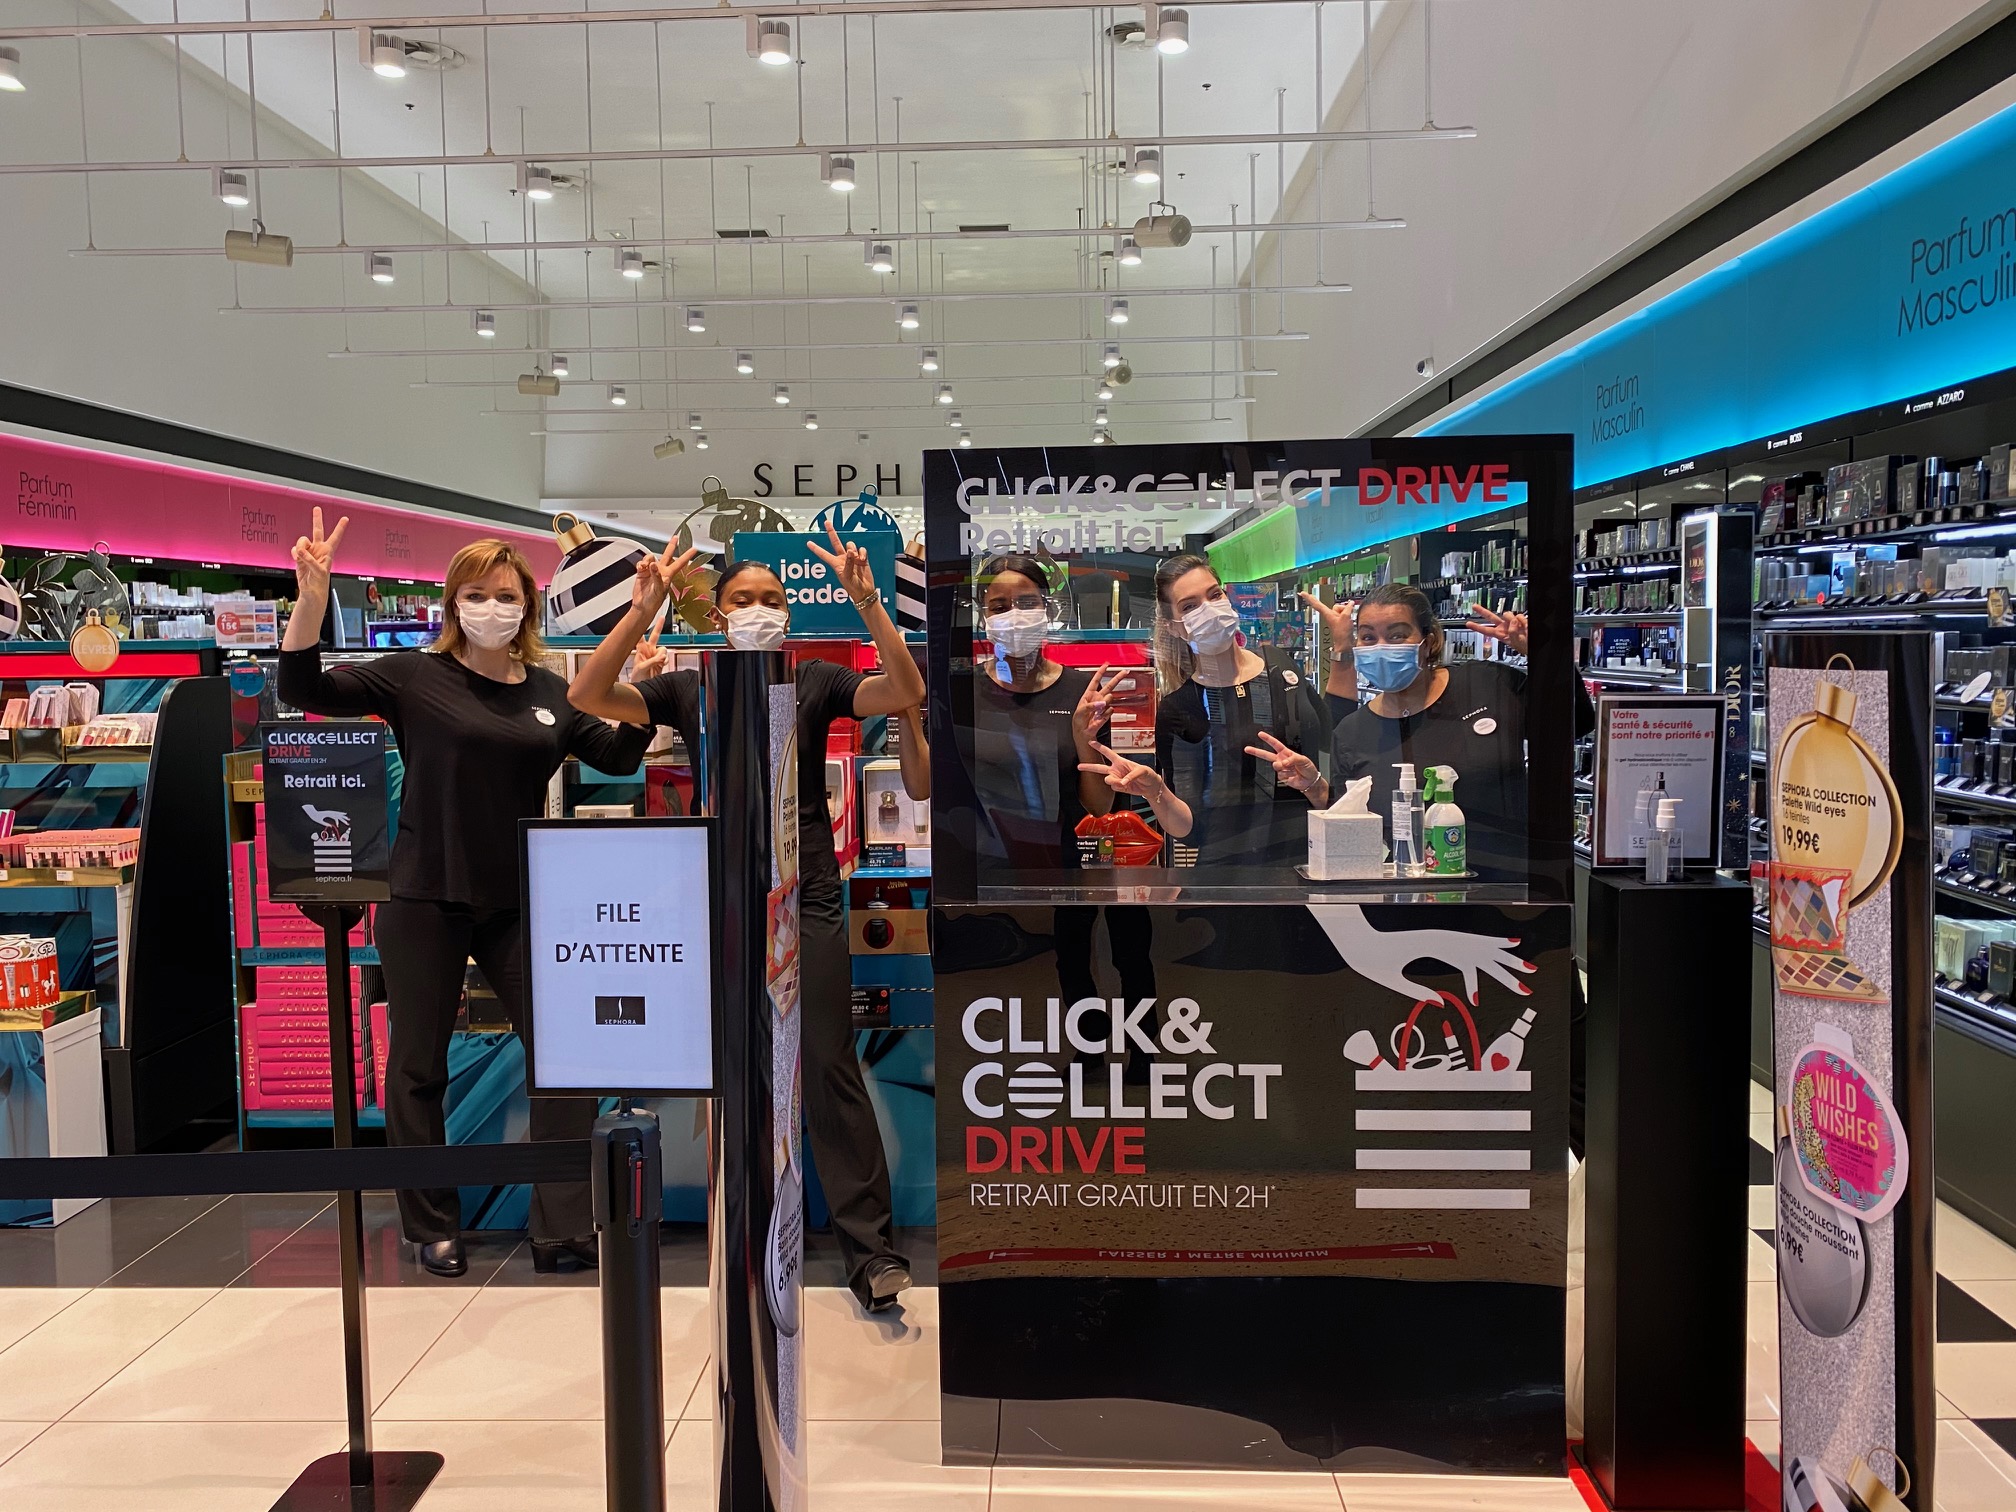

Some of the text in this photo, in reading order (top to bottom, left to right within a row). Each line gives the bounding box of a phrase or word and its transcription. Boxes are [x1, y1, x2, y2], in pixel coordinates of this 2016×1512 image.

[1911, 207, 2016, 284] Parfum
[1597, 375, 1639, 413] Parfum
[1904, 390, 1964, 414] A comme AZZARO
[1592, 401, 1644, 445] Masculin
[1790, 432, 1802, 444] BOSS
[19, 472, 73, 498] Parfum
[753, 463, 902, 497] SEPH
[1358, 464, 1510, 506] DRIVE
[18, 495, 77, 521] Féminin
[242, 506, 276, 527] Parfum
[241, 525, 279, 544] Féminin
[386, 529, 408, 546] Parfum
[959, 518, 1178, 555] Retrait ici.
[386, 544, 410, 559] Féminin
[780, 558, 827, 583] joie
[785, 584, 889, 604] cade.
[221, 622, 237, 630] 15€
[1725, 663, 1742, 722] DIOR
[1612, 711, 1639, 719] Votre
[1612, 720, 1693, 729] santé & sécurité
[1611, 730, 1714, 741] sont notre priorité #1
[268, 746, 312, 758] DRIVE
[284, 774, 366, 788] Retrait ici.
[1782, 781, 1876, 807] SEPHORA COLLECTION
[1782, 795, 1846, 818] Palette Wild eyes
[1790, 809, 1810, 824] teintes
[1632, 837, 1682, 845] SERA
[1782, 824, 1820, 854] 19,99€
[315, 875, 352, 883] sephora.fr
[596, 903, 641, 923] FILE
[283, 936, 323, 945] SEPHO
[253, 951, 375, 960] SEPHORA COTION
[555, 942, 684, 963] D'ATTENTE
[280, 971, 327, 979] SEPHOR
[280, 987, 328, 996] SEPHOR
[279, 1003, 328, 1012] SEPHOR
[280, 1019, 328, 1027] SEPHOR
[961, 996, 1218, 1055] CLICK&
[281, 1035, 329, 1043] SEPHOR
[283, 1067, 332, 1075] SEPHOR
[961, 1061, 1283, 1121] COLLECT
[1816, 1070, 1857, 1113] WILD
[1816, 1100, 1879, 1150] WISHES
[965, 1126, 1146, 1174] DRIVE
[970, 1184, 1071, 1206] RETRAIT
[1077, 1184, 1185, 1207] GRATUIT
[1193, 1185, 1227, 1208] EN
[1790, 1219, 1809, 1244] wishes
[1790, 1208, 1813, 1233] douche
[1814, 1229, 1860, 1261] moussant
[1802, 1206, 1856, 1246] COLLECTION
[1780, 1225, 1803, 1263] 6,99€
[778, 1250, 798, 1292] 6,99€
